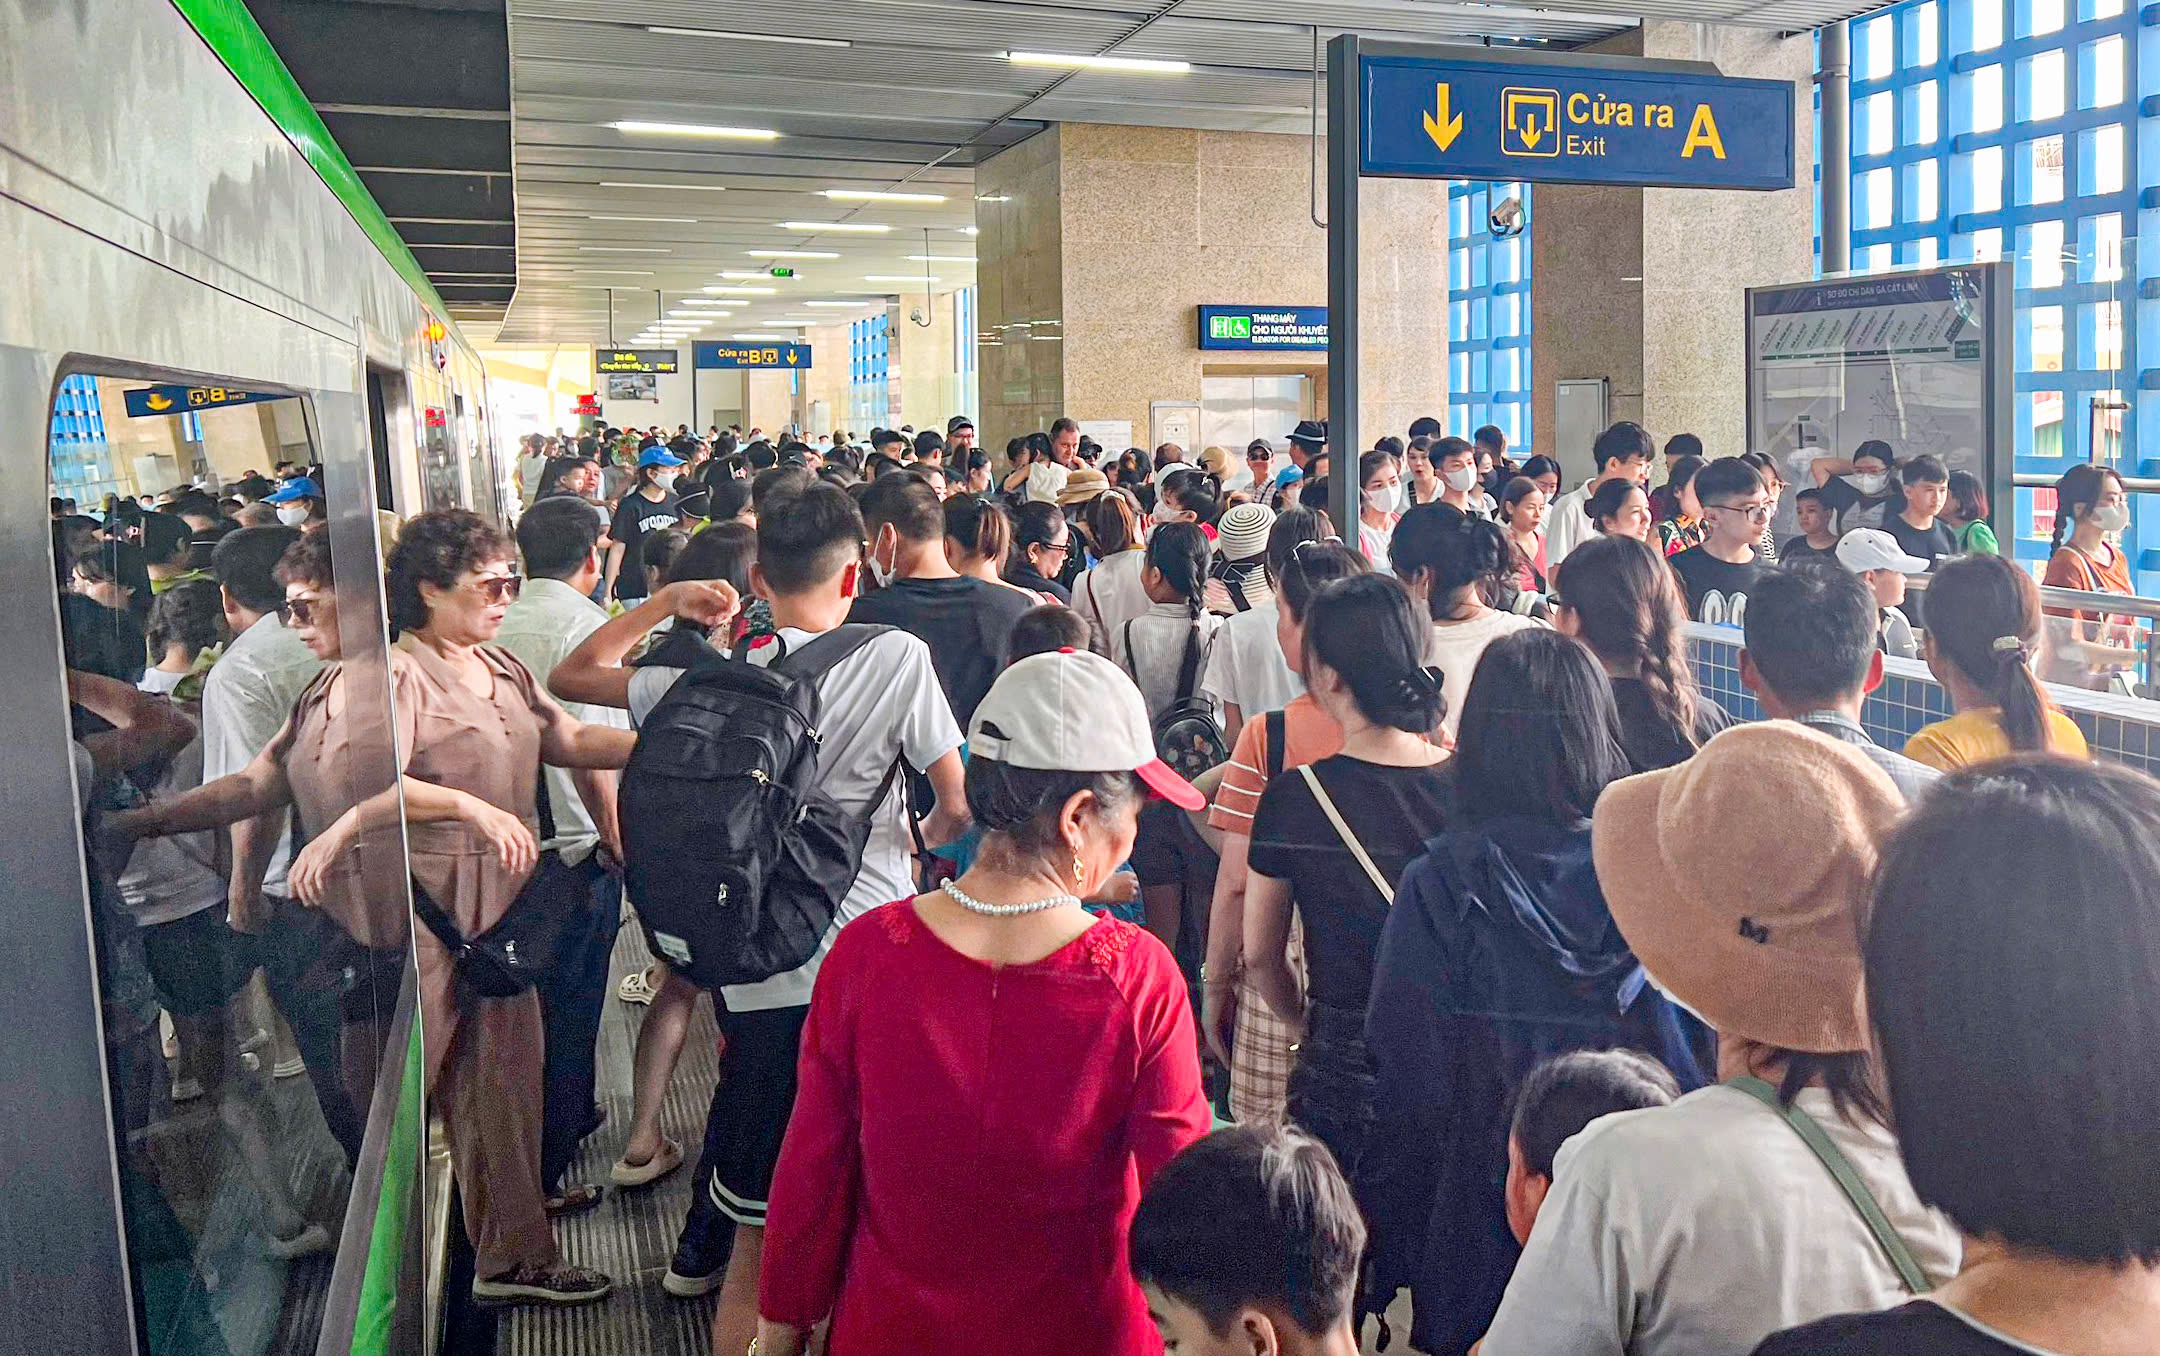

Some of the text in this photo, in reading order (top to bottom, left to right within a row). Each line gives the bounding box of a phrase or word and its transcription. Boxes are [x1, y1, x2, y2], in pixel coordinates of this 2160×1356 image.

[1566, 92, 1674, 128] Cửa ra
[1681, 103, 1727, 159] A
[1566, 135, 1606, 157] Exit
[1252, 312, 1297, 323] THANG MÁY
[1252, 325, 1270, 335] CHO
[1252, 336, 1279, 344] ELEVATOR
[1279, 336, 1291, 344] FOR
[1317, 336, 1329, 344] PEO
[749, 349, 761, 364] B
